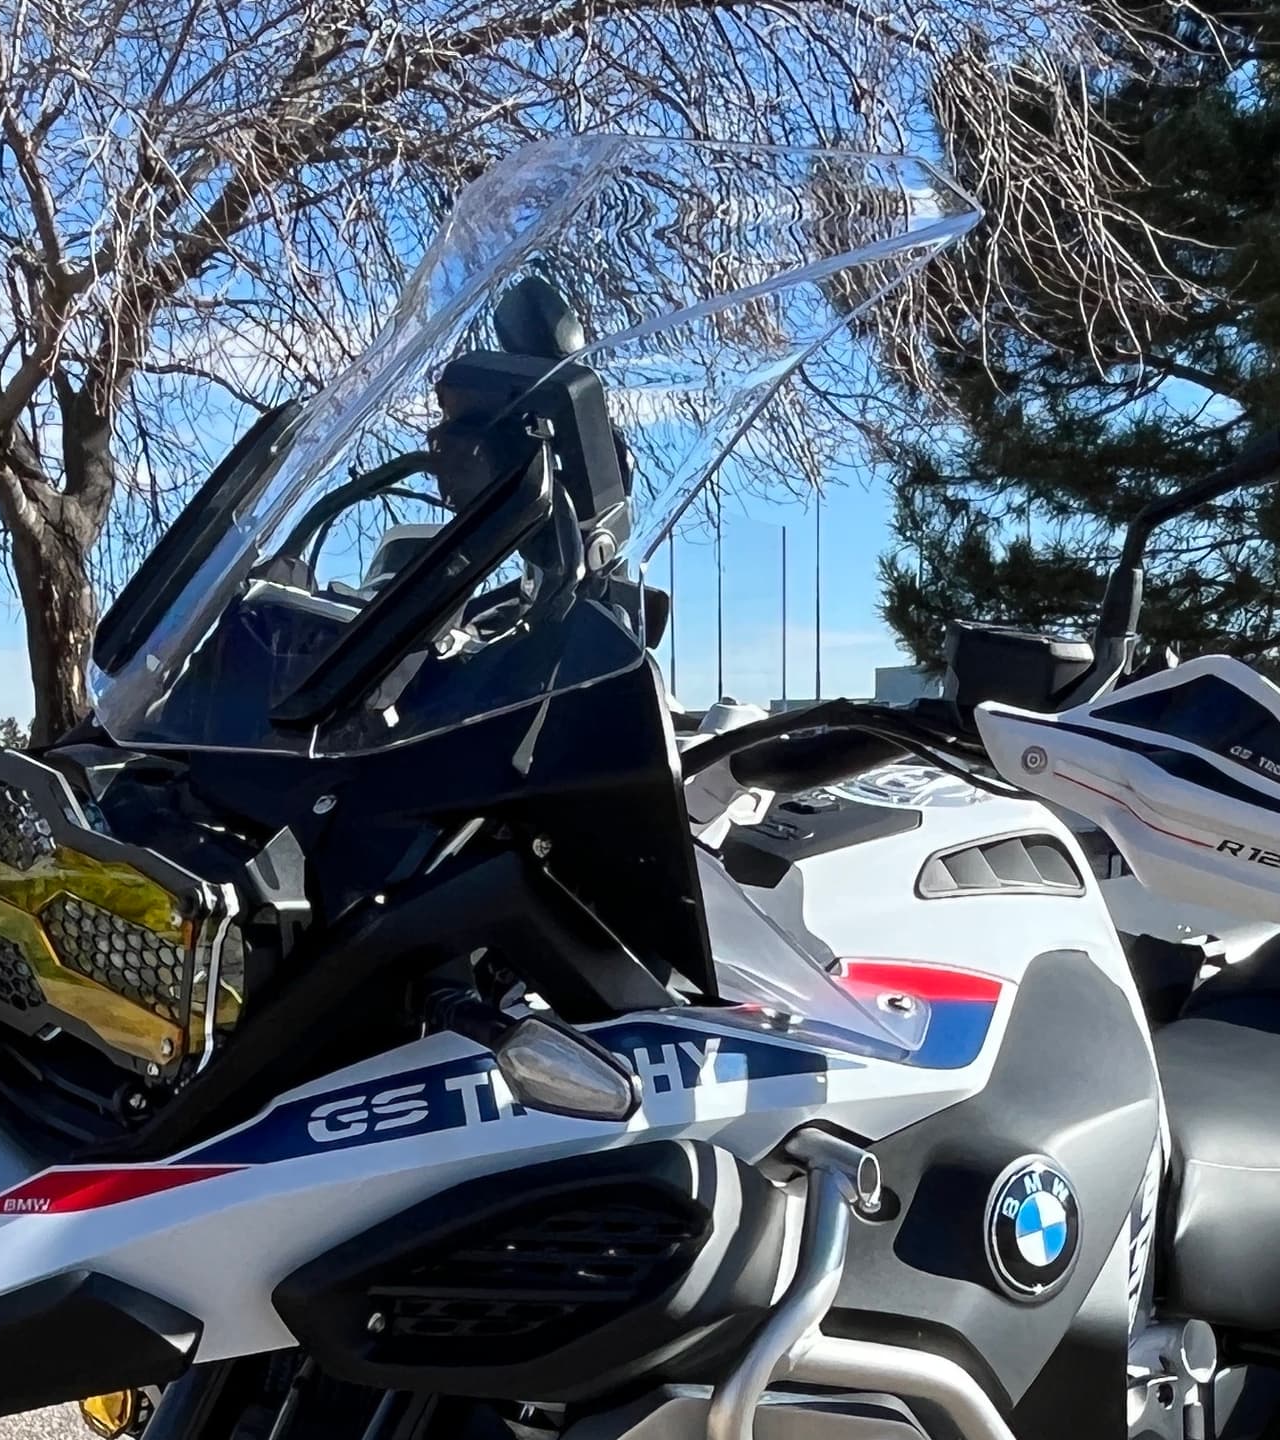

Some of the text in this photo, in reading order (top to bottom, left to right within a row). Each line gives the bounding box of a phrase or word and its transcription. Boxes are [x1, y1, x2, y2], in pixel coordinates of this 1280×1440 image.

[1230, 745, 1253, 760] GS
[1216, 839, 1245, 857] R
[307, 1038, 721, 1142] GS THY
[3, 1197, 51, 1212] BMW
[1002, 1173, 1069, 1220] BMW
